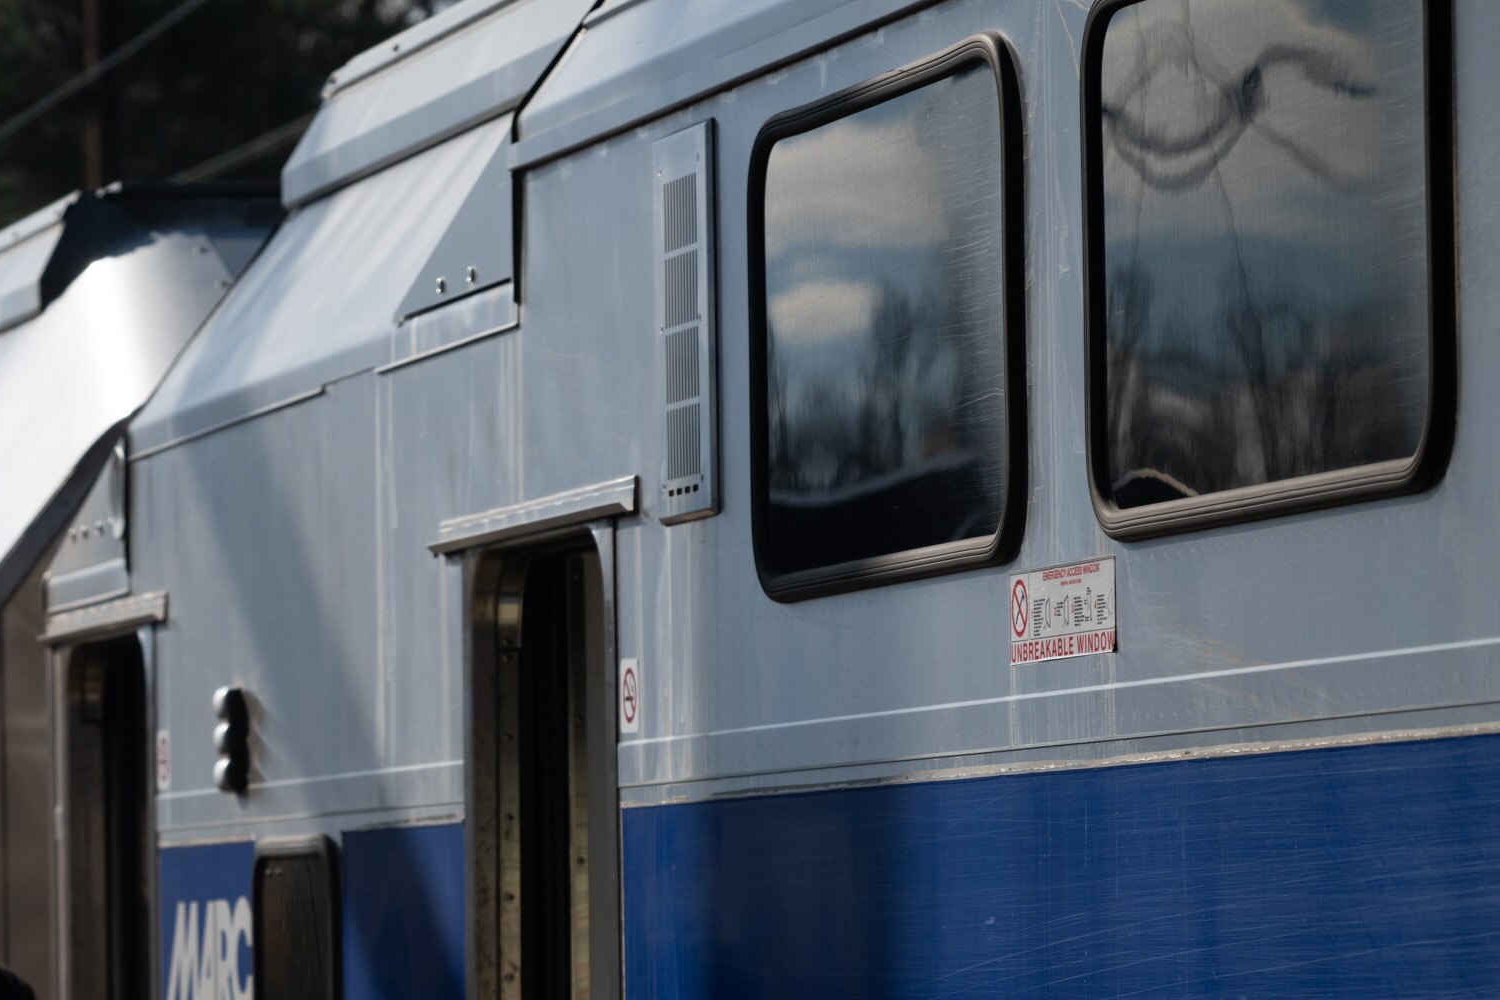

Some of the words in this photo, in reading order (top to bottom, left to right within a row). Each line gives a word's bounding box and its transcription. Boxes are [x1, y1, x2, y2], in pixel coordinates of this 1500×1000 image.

[1067, 566, 1082, 578] ACCESS
[1083, 563, 1100, 575] WINDOW
[1011, 636, 1074, 663] UNBREAKABLE
[1077, 630, 1116, 653] WINDOW
